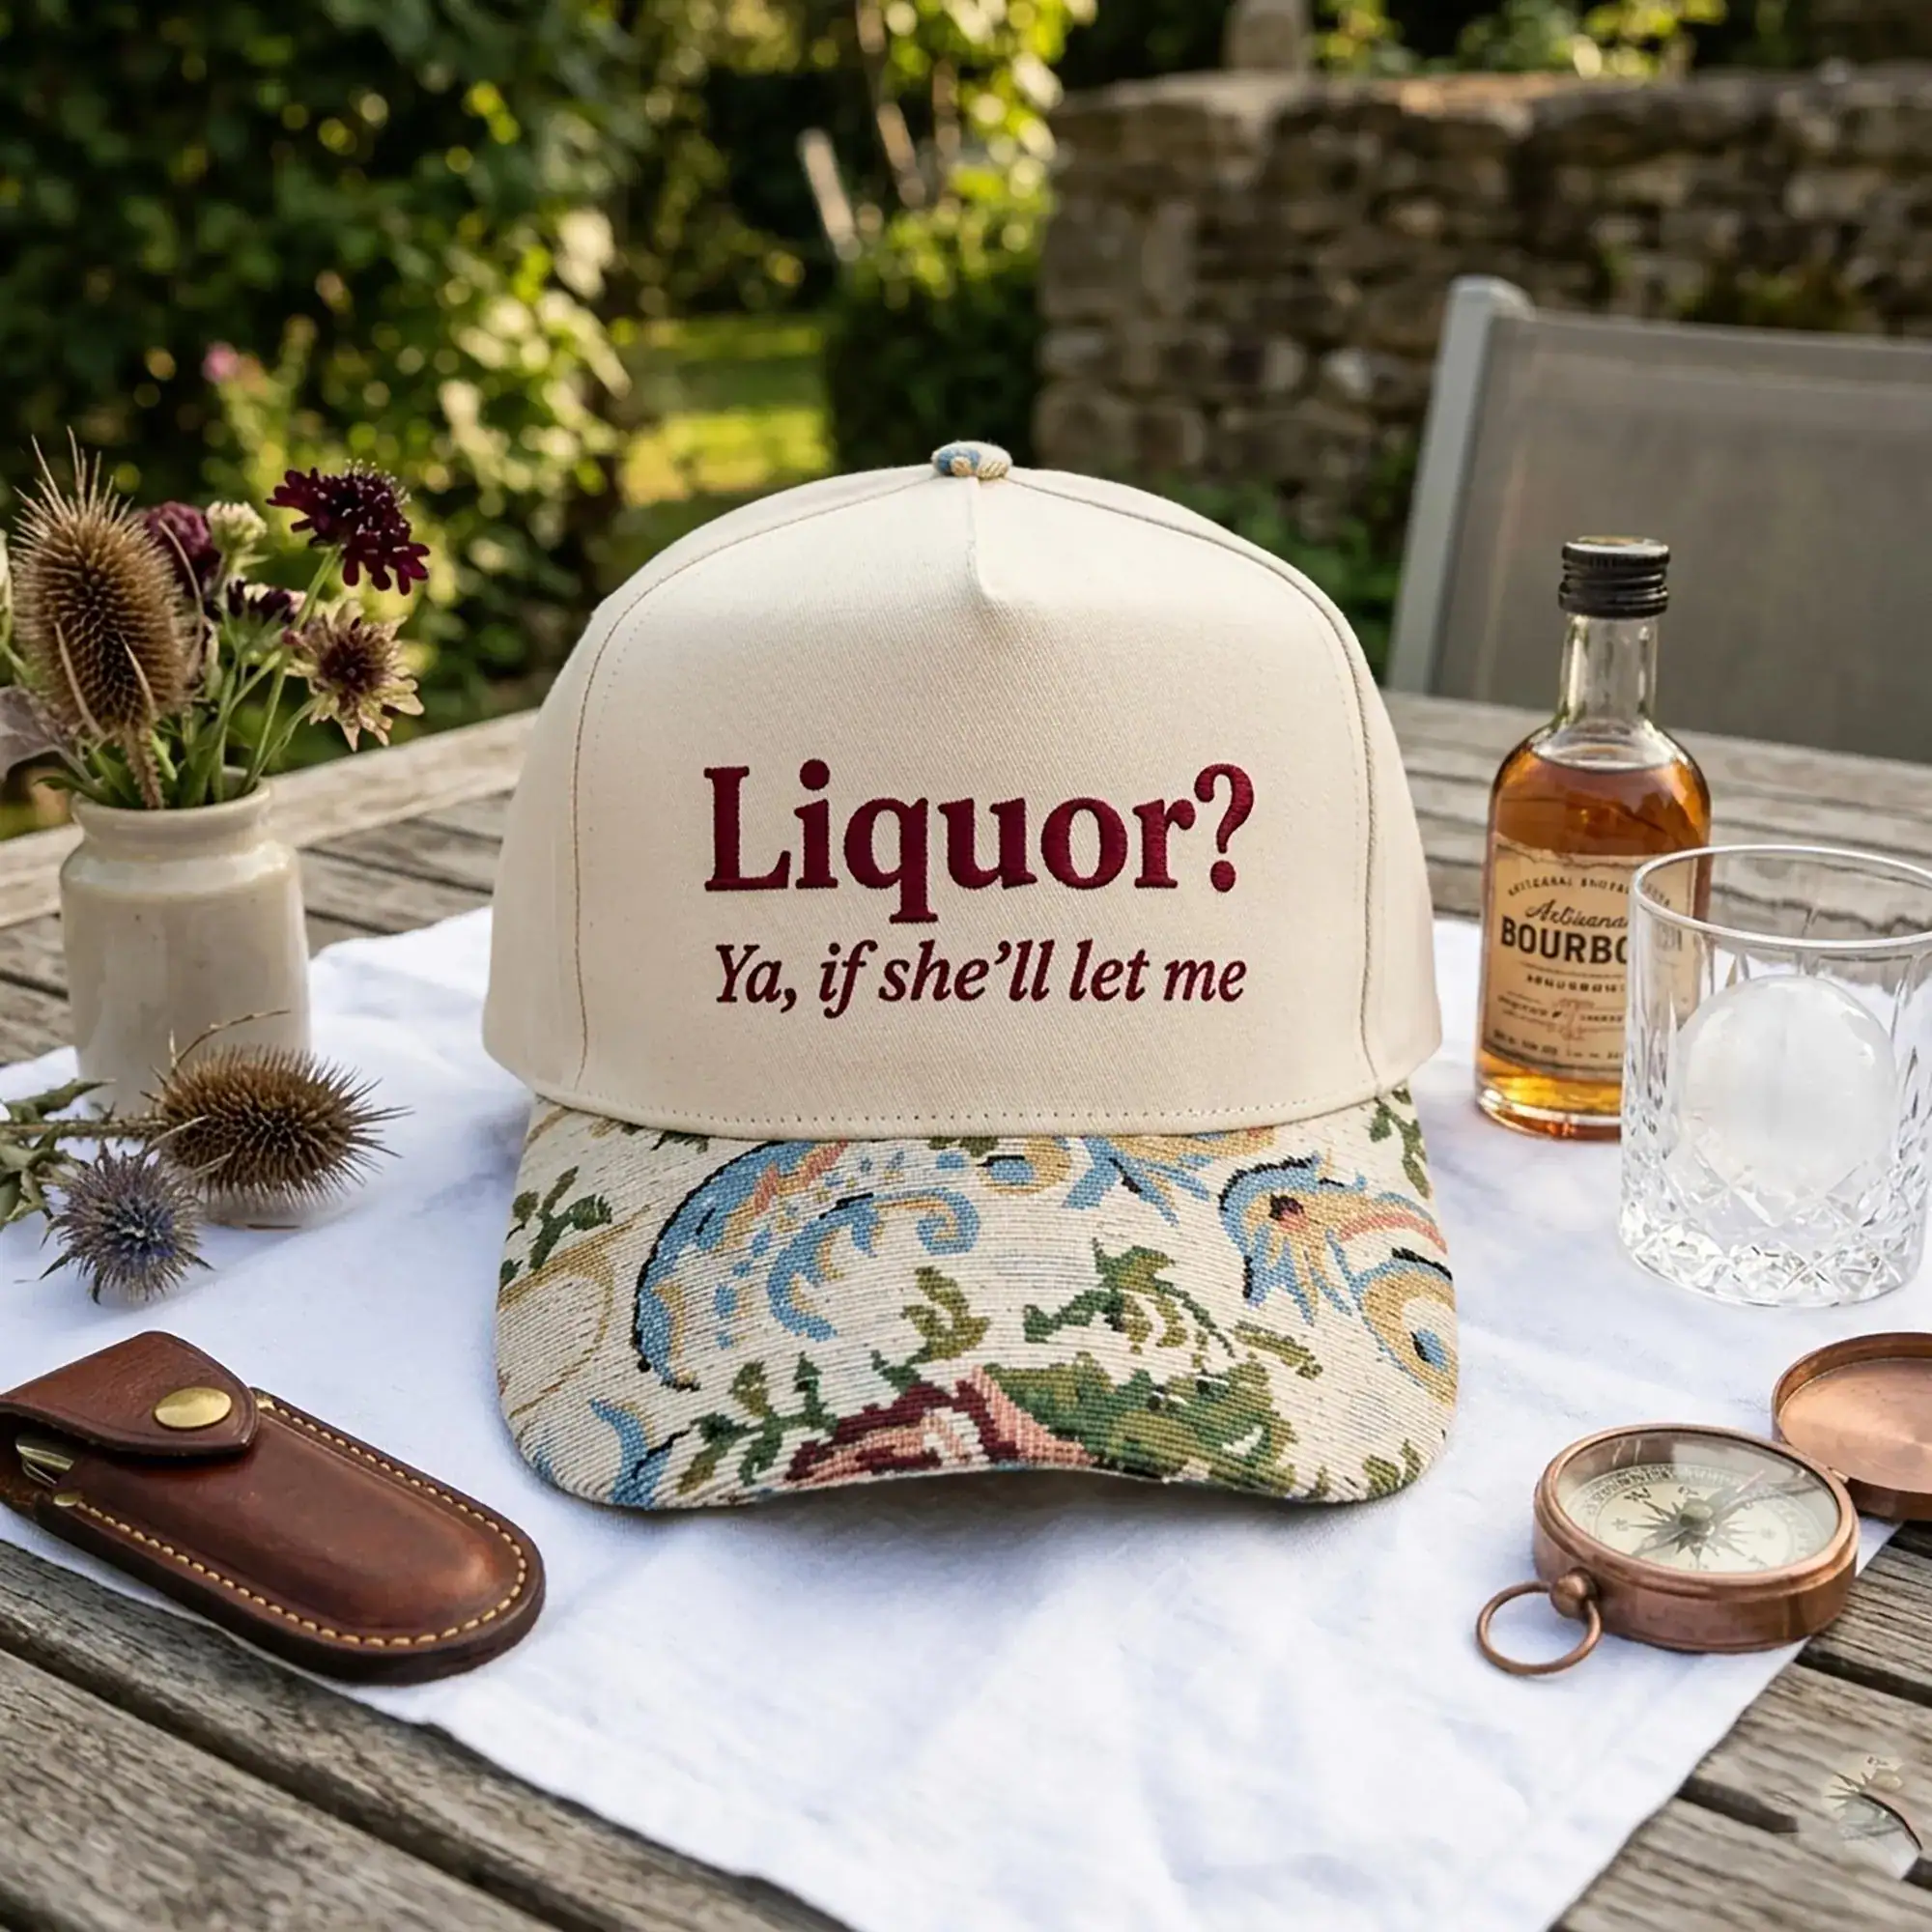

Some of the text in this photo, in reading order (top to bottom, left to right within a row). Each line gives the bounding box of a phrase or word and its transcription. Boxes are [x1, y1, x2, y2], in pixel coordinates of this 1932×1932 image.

[703, 758, 1255, 924] Liquor?
[715, 938, 1247, 1019] Ya, if she’ll let me
[1500, 915, 1629, 964] BOURBO
